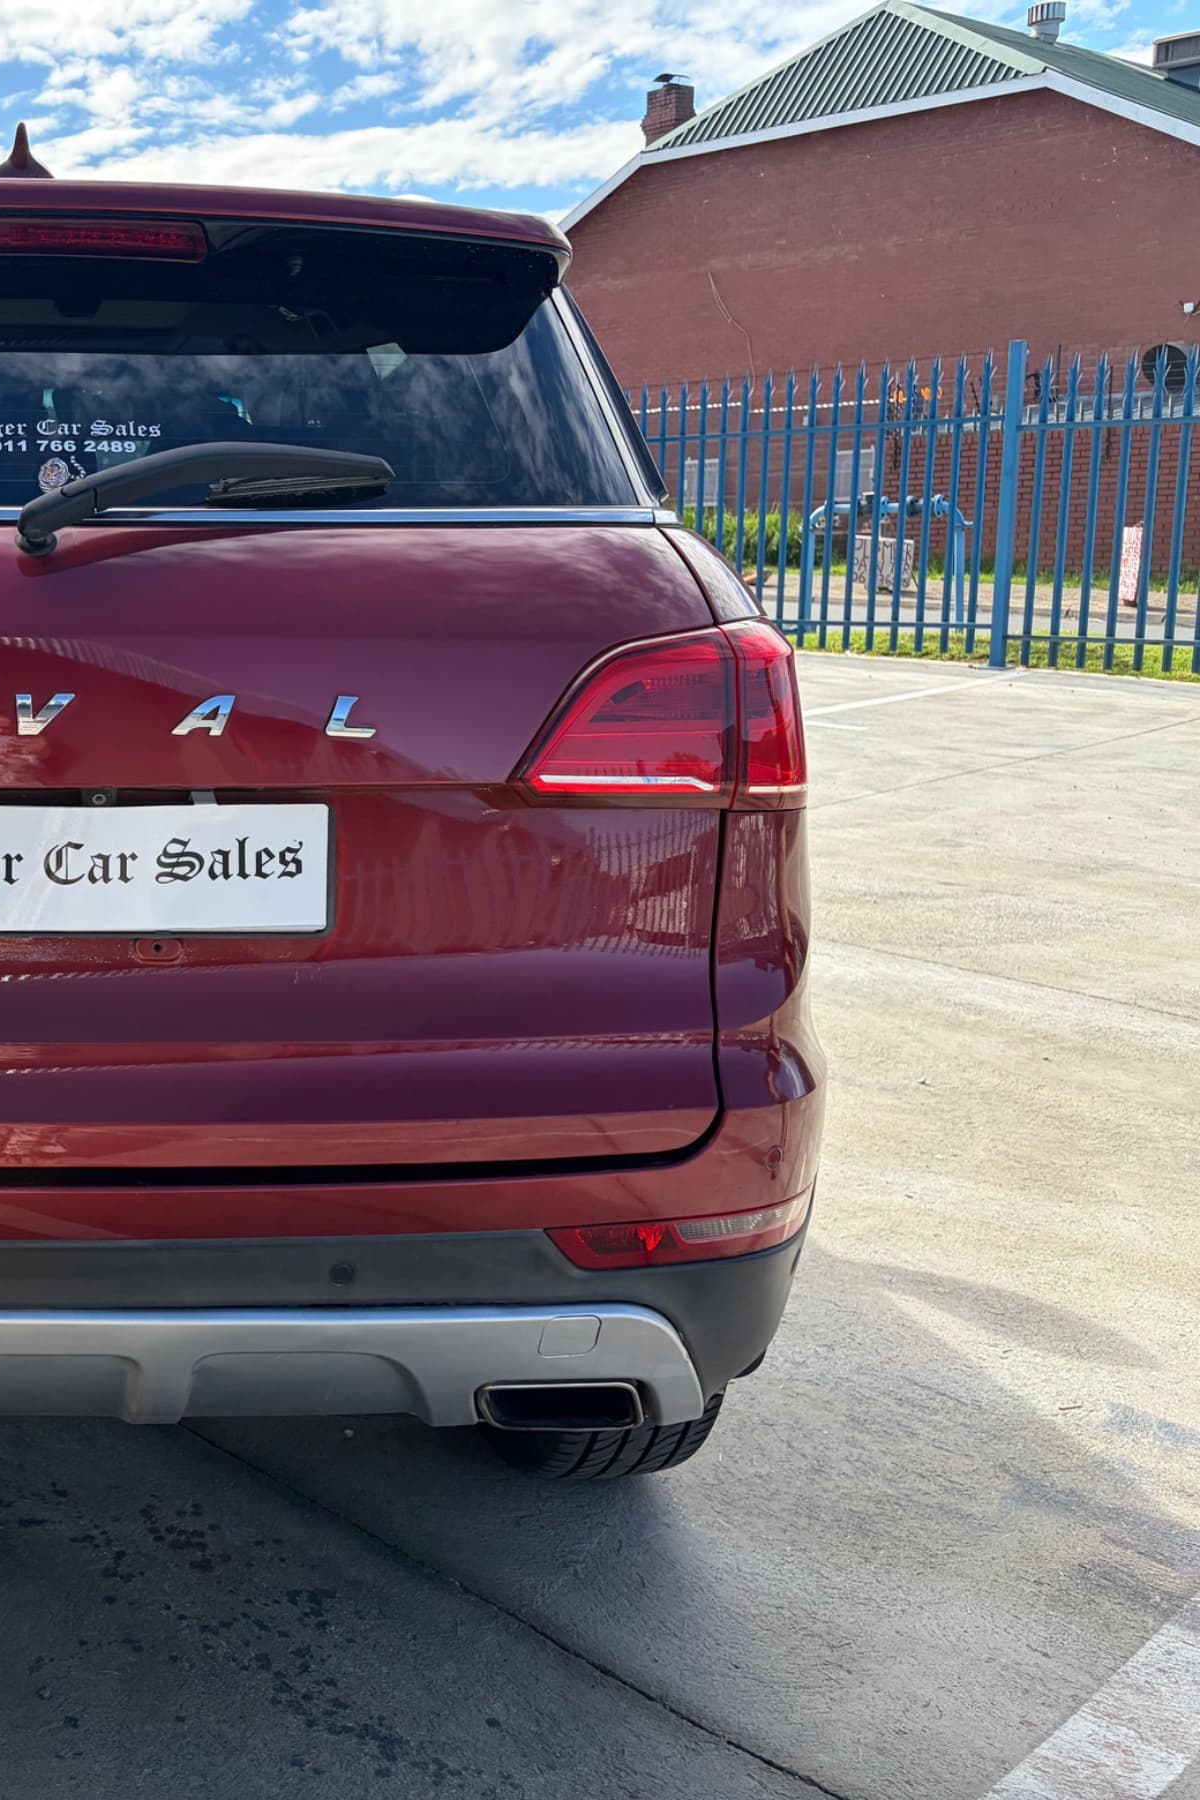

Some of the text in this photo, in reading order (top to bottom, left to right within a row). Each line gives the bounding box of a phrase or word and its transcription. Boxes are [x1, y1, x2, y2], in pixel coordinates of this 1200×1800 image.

[36, 418, 82, 437] Car
[89, 418, 161, 438] Sales
[36, 440, 77, 452] 766
[83, 440, 137, 453] 2489
[43, 840, 139, 886] Car
[154, 836, 304, 885] Sales
